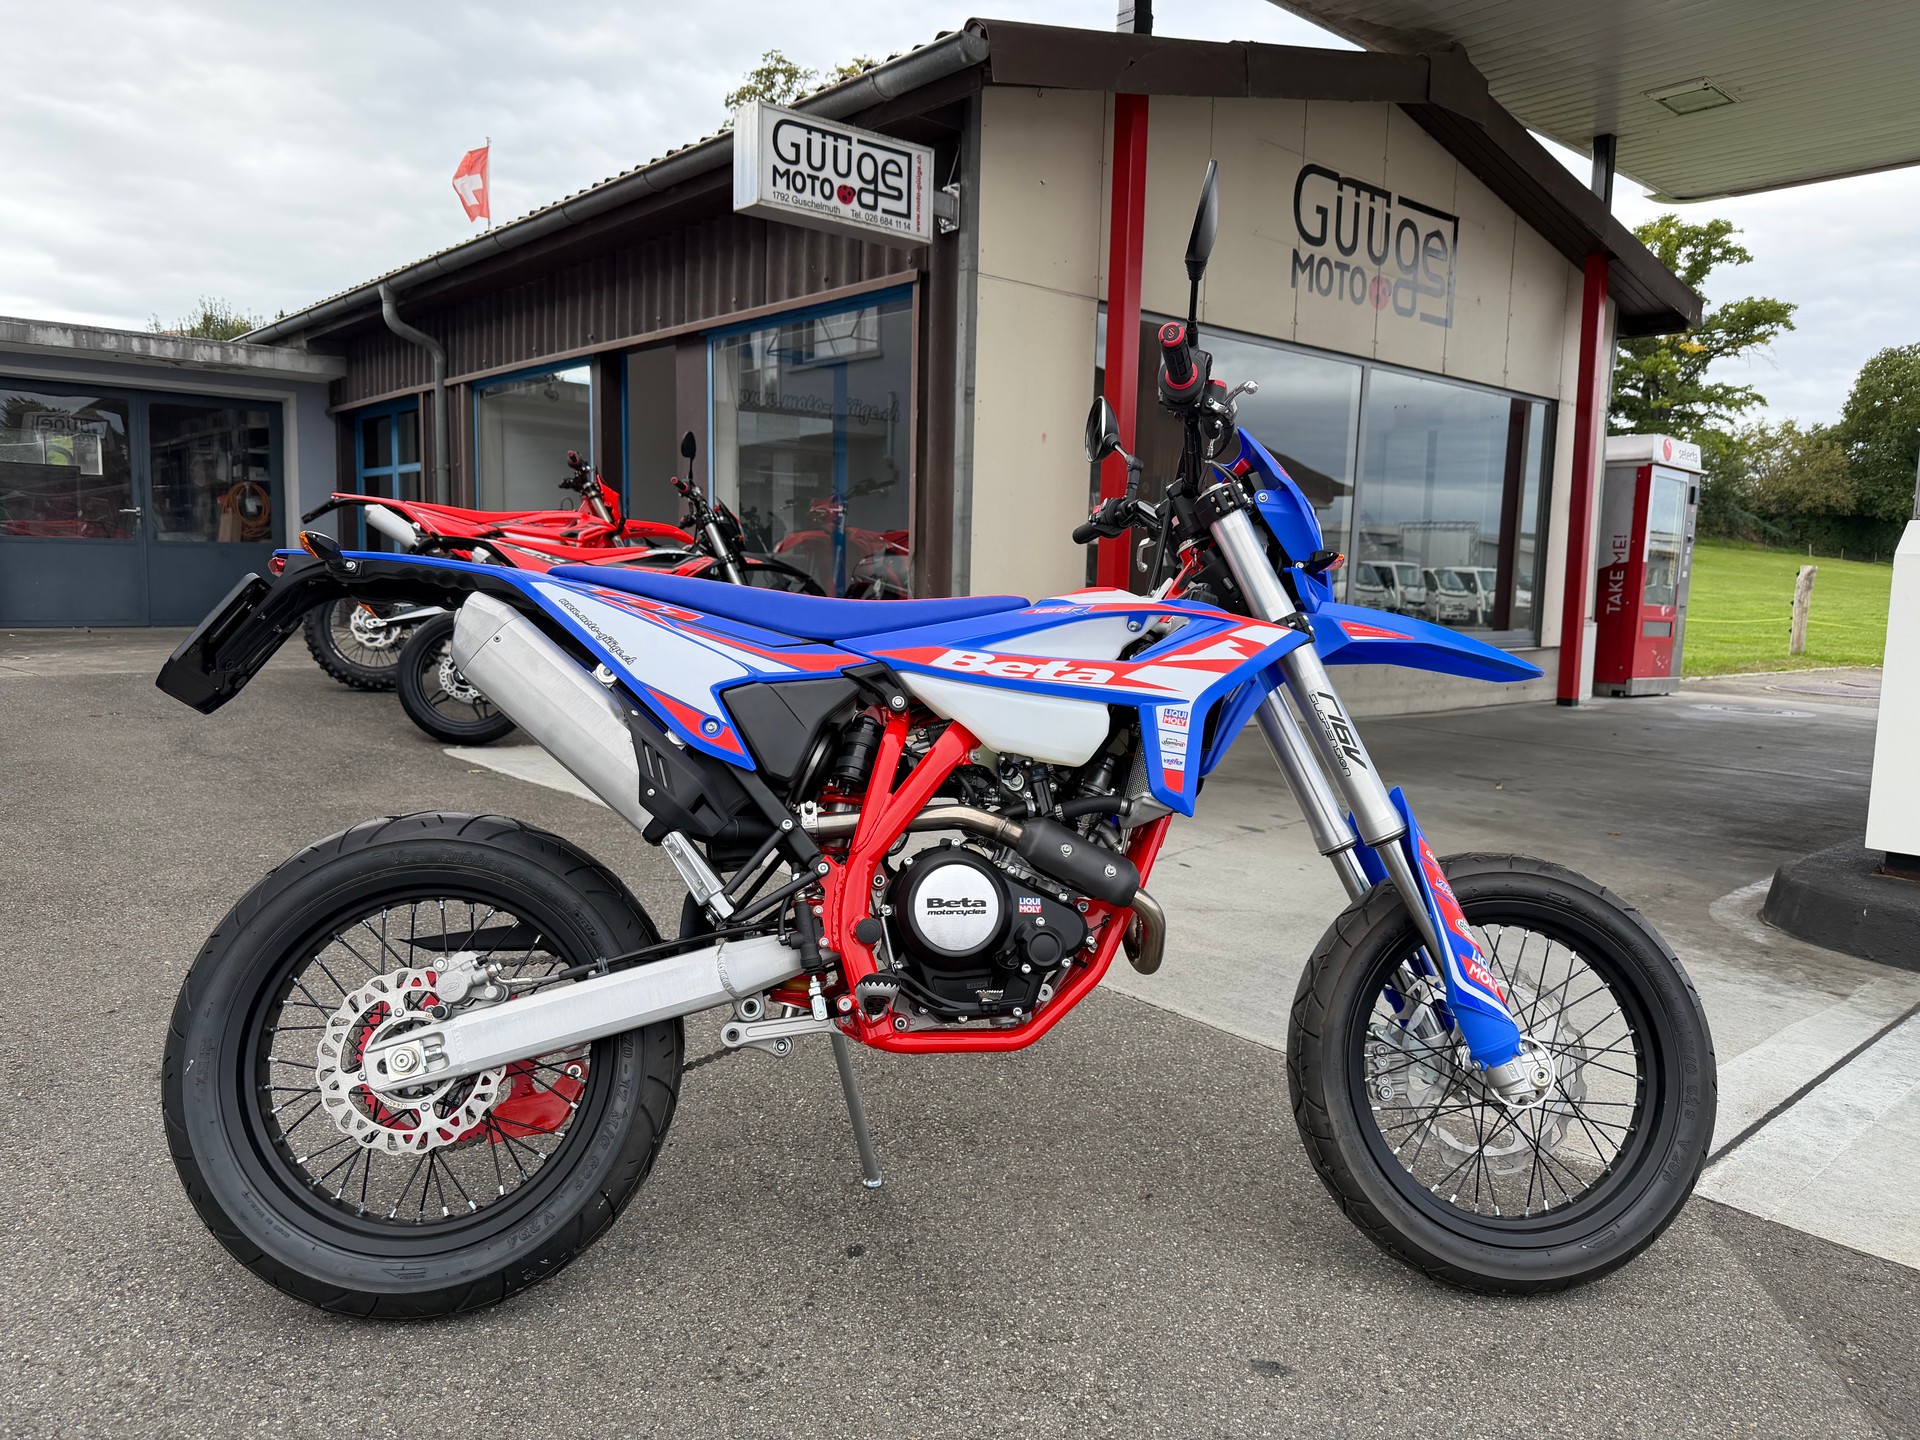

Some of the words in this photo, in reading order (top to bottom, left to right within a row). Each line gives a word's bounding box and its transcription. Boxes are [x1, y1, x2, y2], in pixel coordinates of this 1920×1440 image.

[773, 164, 834, 200] MOTO
[772, 191, 790, 202] 1792
[791, 196, 841, 214] Guschelmuth
[851, 209, 862, 218] Tel.
[864, 213, 879, 223] 026
[880, 219, 893, 227] 684
[895, 220, 902, 228] 11
[903, 222, 911, 230] 14
[1291, 248, 1367, 305] MOTO
[1678, 449, 1698, 463] selecta
[1611, 534, 1628, 566] ME!
[1606, 570, 1624, 614] TAKE
[929, 649, 1115, 684] Beta
[1163, 716, 1187, 727] MOLY
[1165, 709, 1188, 719] LIQUI
[926, 897, 987, 909] Beta
[1019, 897, 1041, 906] LIQUI
[1019, 905, 1041, 913] MOLY
